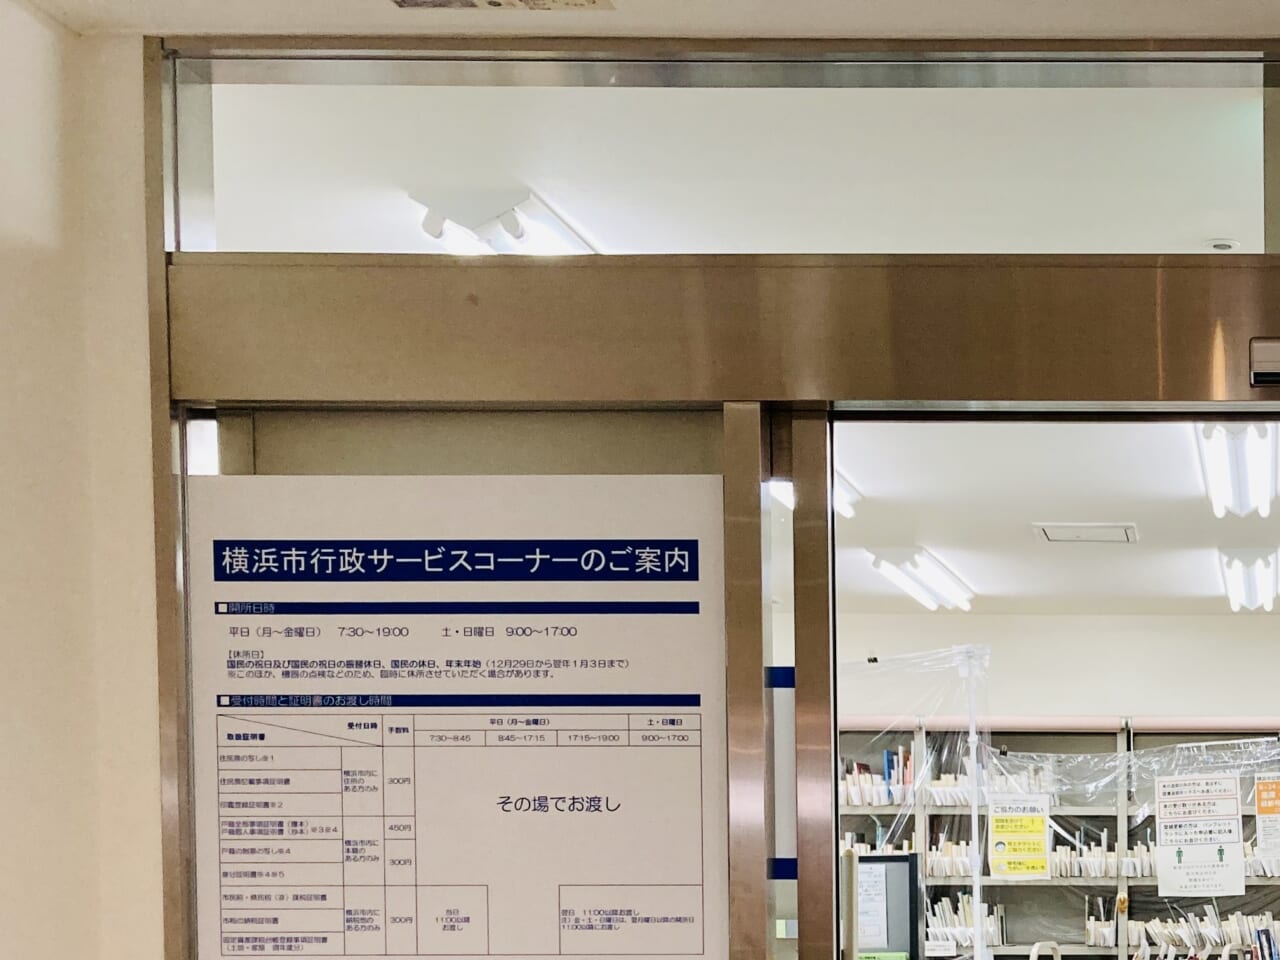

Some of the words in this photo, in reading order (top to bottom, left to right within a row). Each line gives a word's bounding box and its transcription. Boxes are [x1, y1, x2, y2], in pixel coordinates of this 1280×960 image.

[222, 546, 690, 575] 横浜市行政サービスコーナーのご案内
[496, 795, 621, 813] その場でお渡し
